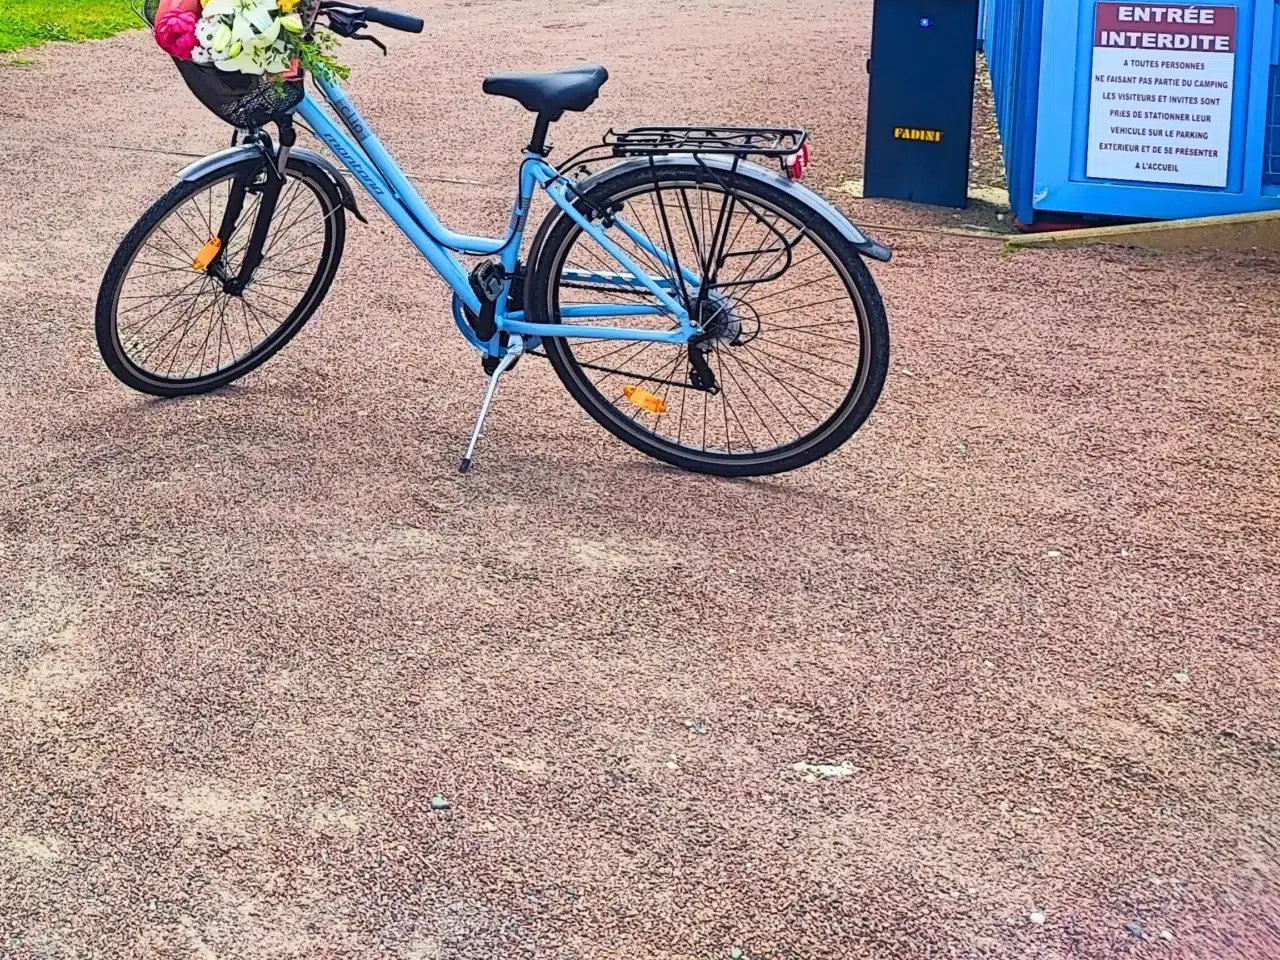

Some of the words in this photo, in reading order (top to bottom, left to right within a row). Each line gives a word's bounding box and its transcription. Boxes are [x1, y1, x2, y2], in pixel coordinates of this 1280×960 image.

[1119, 6, 1214, 24] ENTRÉE
[1101, 31, 1230, 50] INTERDITE
[1131, 60, 1159, 68] TOUTES
[1161, 61, 1205, 70] PERSONNES
[1107, 76, 1136, 84] FAISANT
[1154, 78, 1180, 86] PARTIE
[1182, 79, 1192, 87] DU
[1194, 80, 1228, 89] CAMPING
[1103, 92, 1116, 100] LES
[1118, 93, 1156, 102] VISITEURS
[1200, 98, 1220, 106] SONT
[1144, 112, 1190, 121] STATIONNER
[894, 128, 940, 142] FADINI
[1148, 129, 1163, 137] SUR
[1165, 130, 1174, 138] LE
[1176, 130, 1208, 140] PARKING
[1153, 146, 1162, 154] DE
[324, 133, 384, 194] montana
[1142, 162, 1179, 172] L'ACCUEIL
